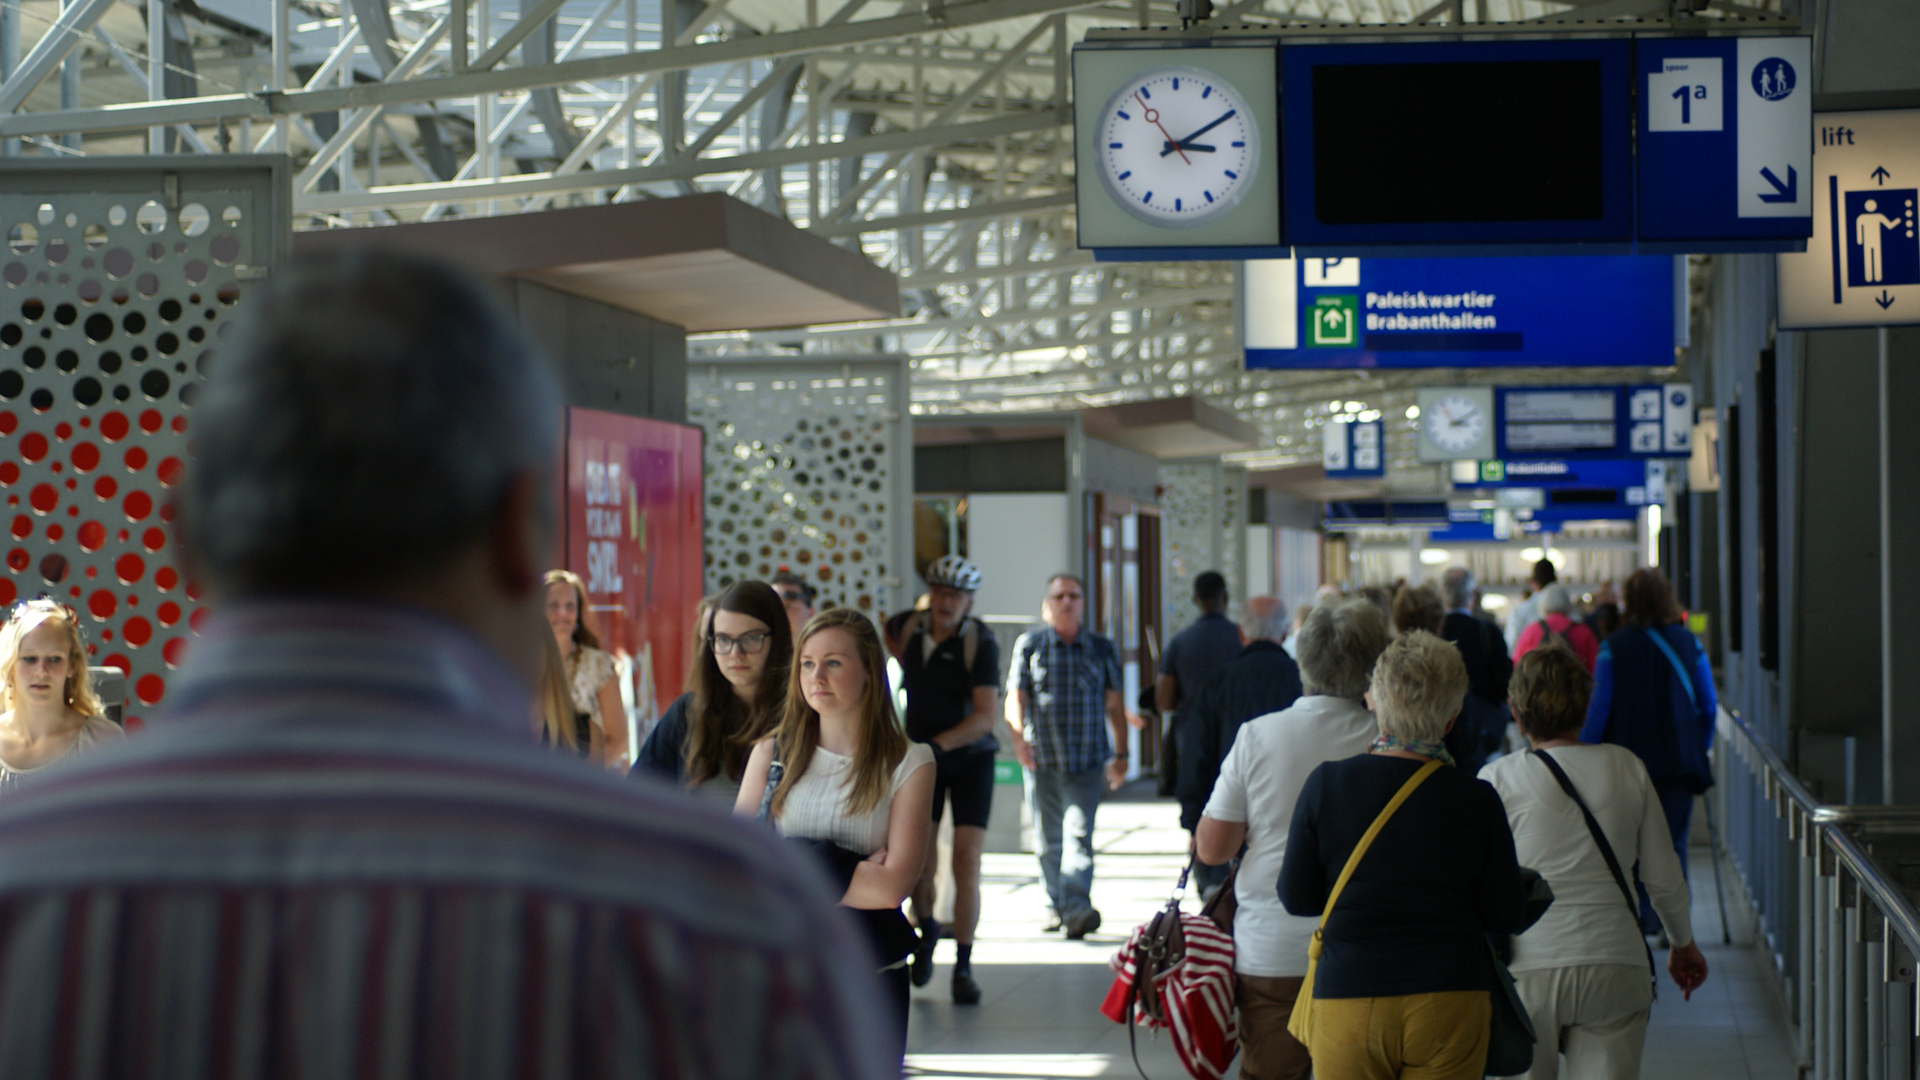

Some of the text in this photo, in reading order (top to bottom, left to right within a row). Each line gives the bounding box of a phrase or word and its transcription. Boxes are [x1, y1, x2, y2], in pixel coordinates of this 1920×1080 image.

[1665, 64, 1689, 72] spoor
[1822, 127, 1855, 146] lift
[1366, 291, 1496, 309] Paleiskwartier
[1366, 312, 1497, 330] Brabanthallen
